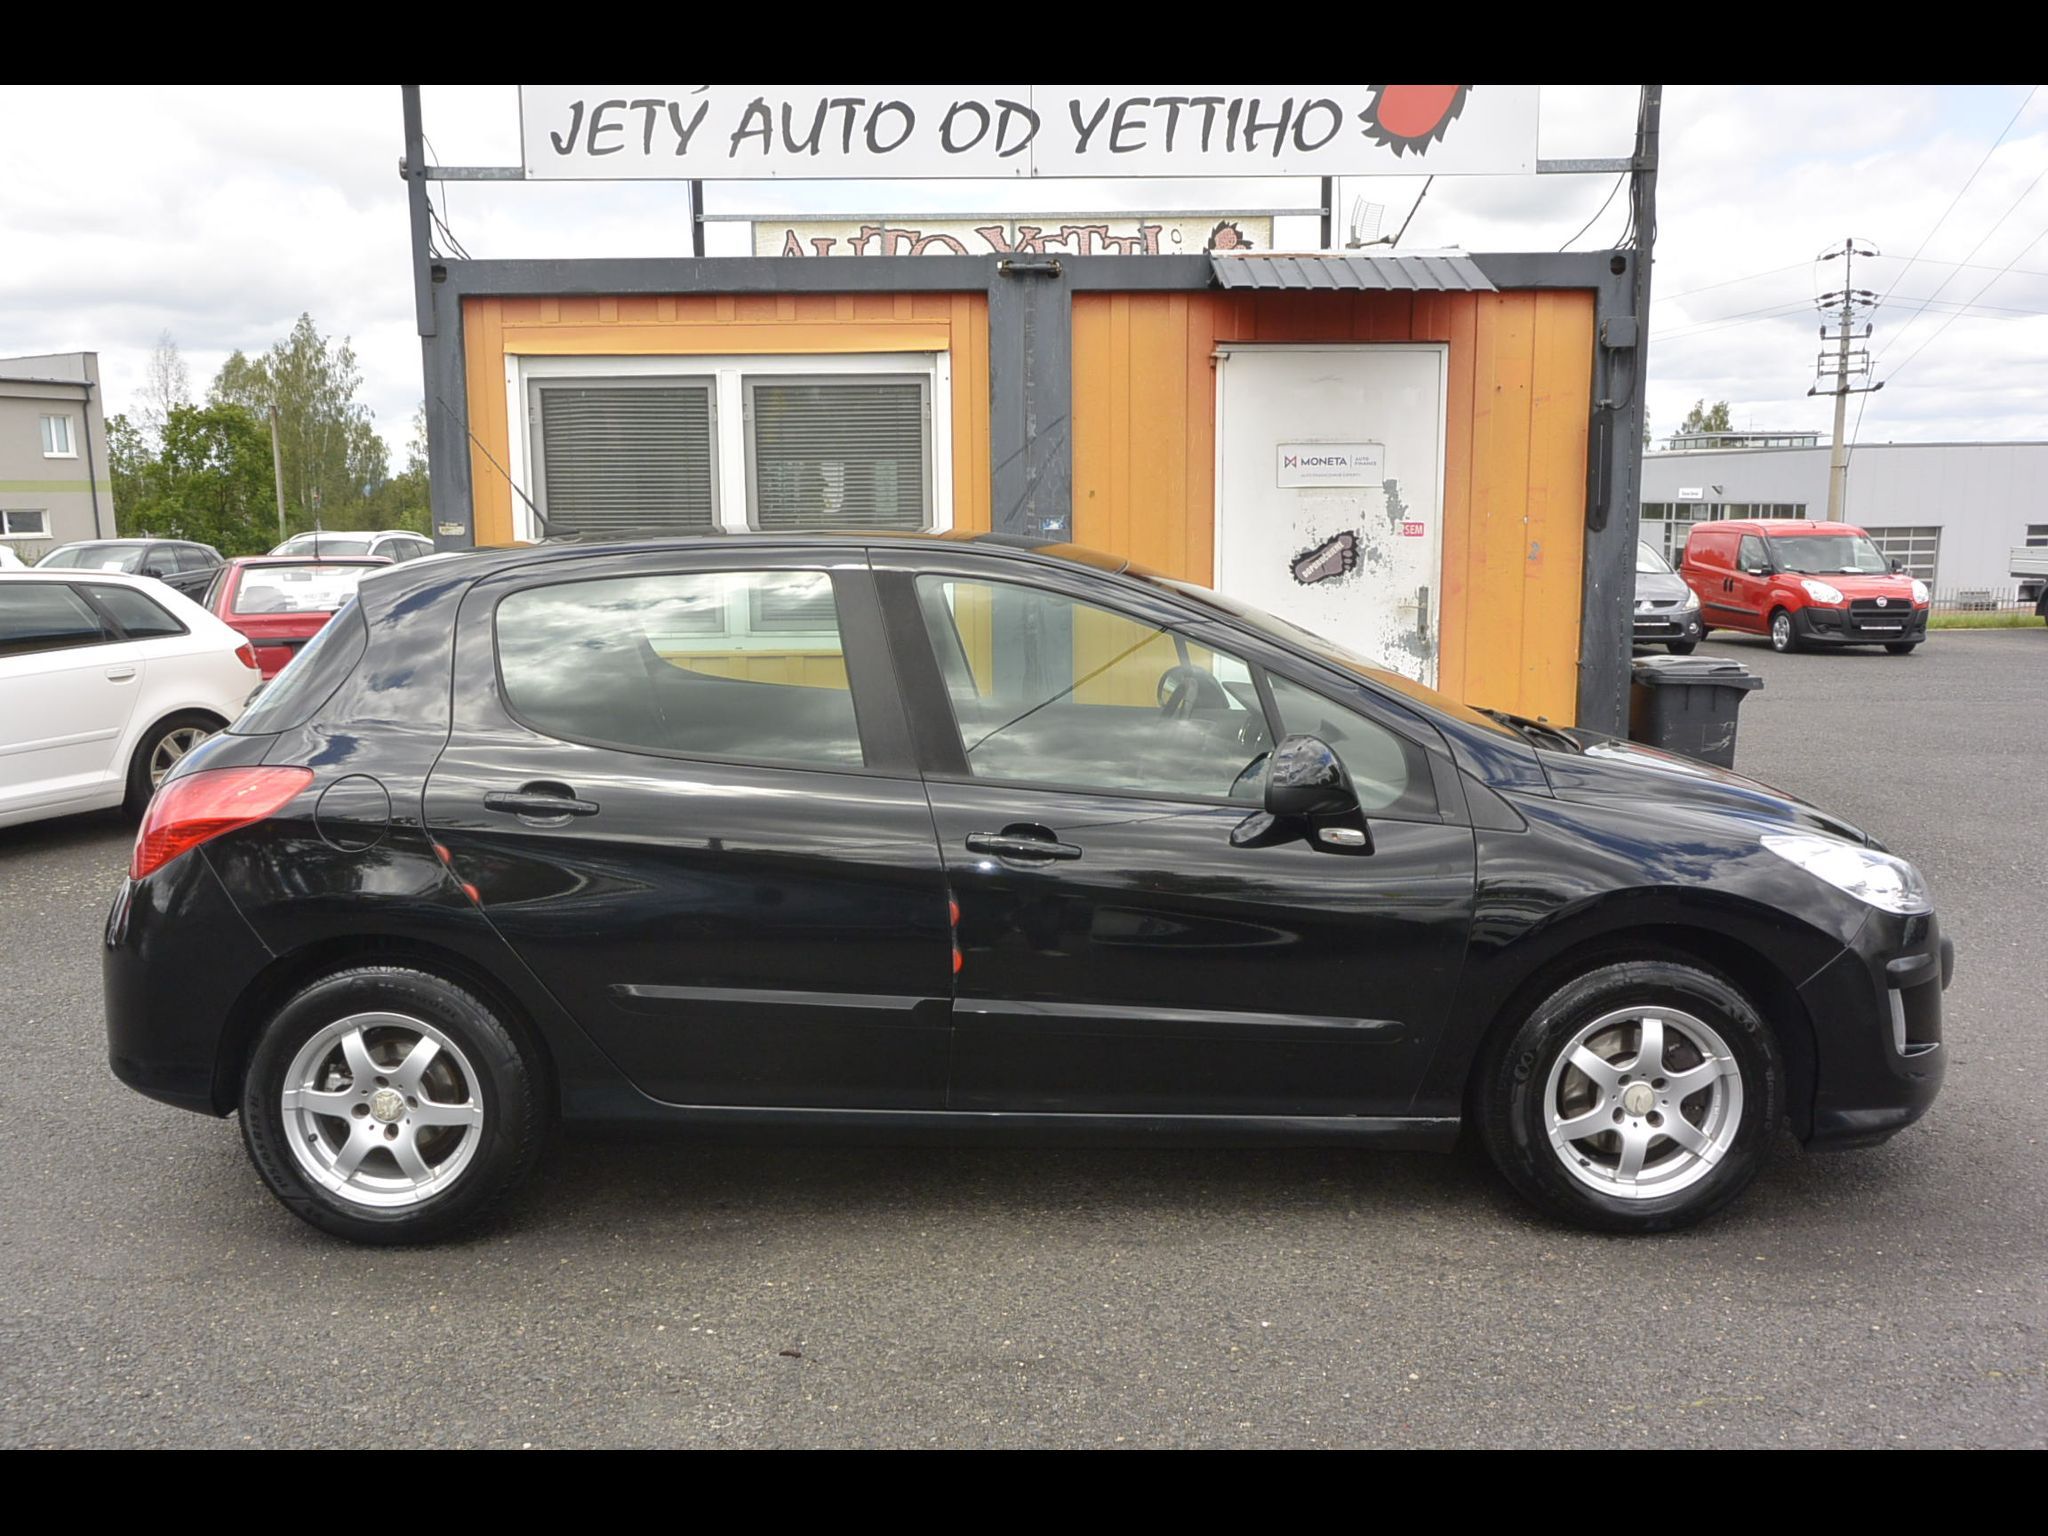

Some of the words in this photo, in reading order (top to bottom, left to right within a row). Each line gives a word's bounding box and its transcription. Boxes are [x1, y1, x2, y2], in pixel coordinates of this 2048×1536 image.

[550, 85, 710, 156] JETÝ
[729, 96, 916, 158] AUTO
[938, 99, 1041, 158] OD
[1068, 96, 1343, 158] YETTIHO
[1300, 456, 1347, 466] MONETA
[1404, 523, 1424, 535] SEM
